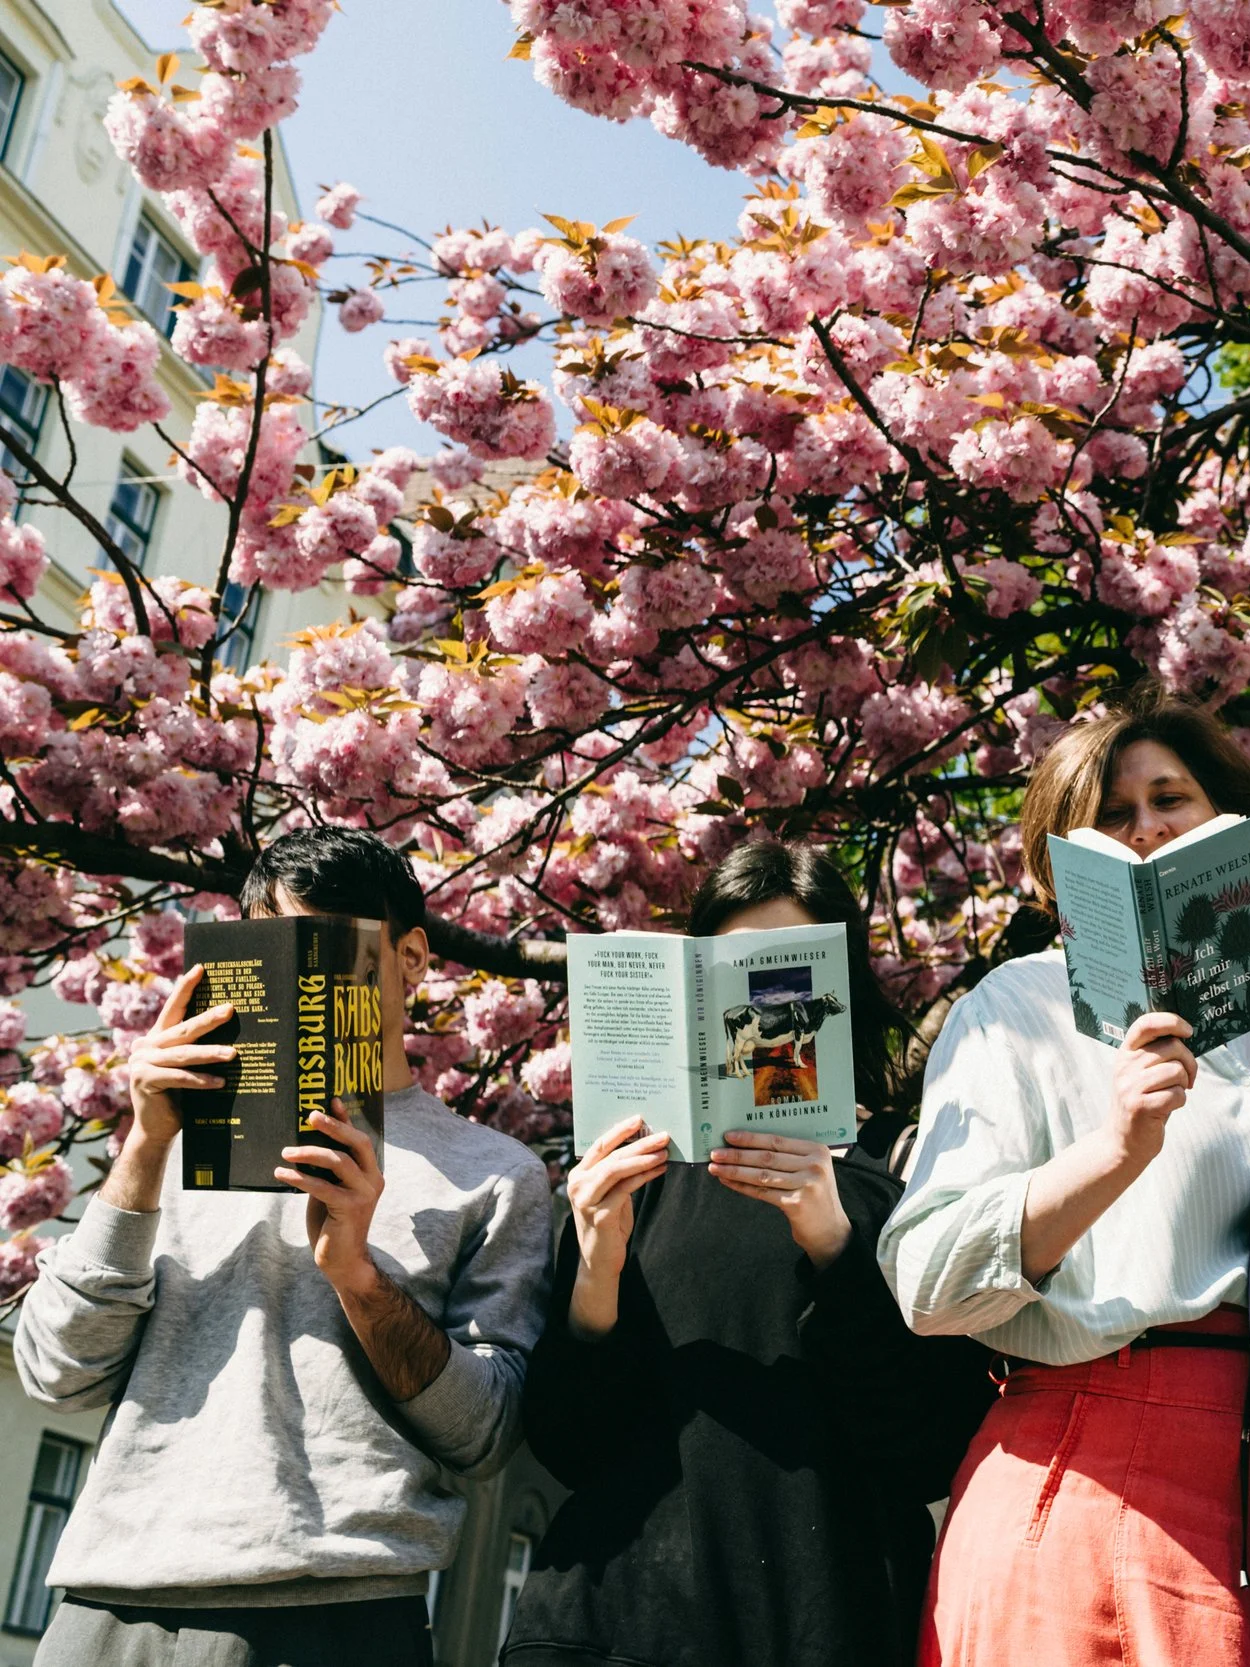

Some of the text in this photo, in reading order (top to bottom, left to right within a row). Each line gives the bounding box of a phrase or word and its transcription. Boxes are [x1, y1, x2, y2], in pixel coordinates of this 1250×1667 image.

[1165, 870, 1213, 900] RENATE
[612, 951, 625, 959] YOUR
[645, 952, 658, 960] FUCK
[733, 950, 827, 969] ANJA GMEINWIESER
[1195, 943, 1215, 962] Ich
[588, 960, 600, 968] YOUR
[649, 962, 666, 970] NEVER
[600, 970, 614, 978] FUCK
[615, 970, 629, 978] YOUR
[1187, 959, 1231, 987] fall mir
[1199, 971, 1250, 1004] selbst ins
[333, 984, 382, 1041] HABS
[1201, 1001, 1235, 1021] Wort
[333, 1040, 383, 1097] BURG
[746, 1104, 829, 1121] WIR KÖNIGINNEN
